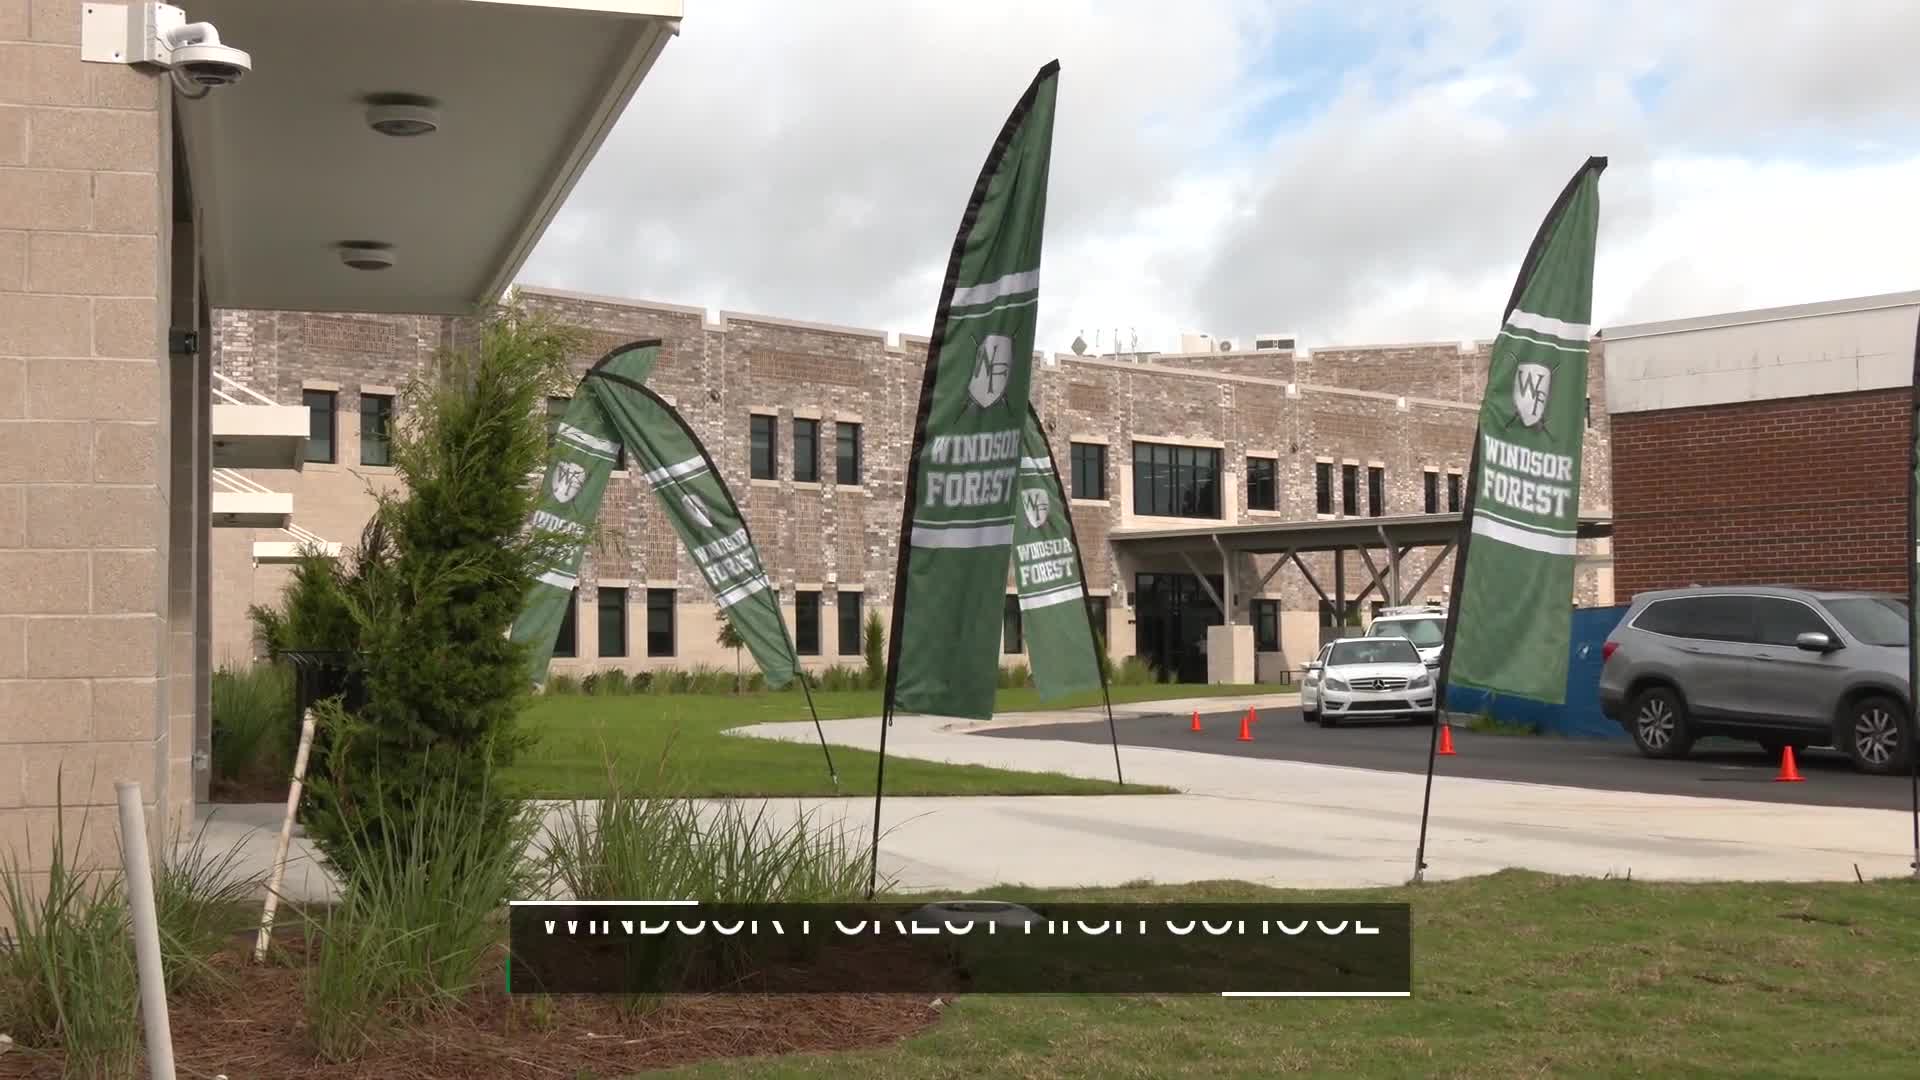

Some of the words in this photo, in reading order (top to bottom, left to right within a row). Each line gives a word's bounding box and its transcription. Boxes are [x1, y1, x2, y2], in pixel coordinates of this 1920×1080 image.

[931, 429, 1020, 464] WINDSOR
[1484, 435, 1572, 480] WINDSOR
[926, 468, 1016, 506] FOREST
[1484, 467, 1571, 518] FOREST
[1017, 538, 1073, 562] WINDSOR
[1020, 557, 1074, 585] FOREST
